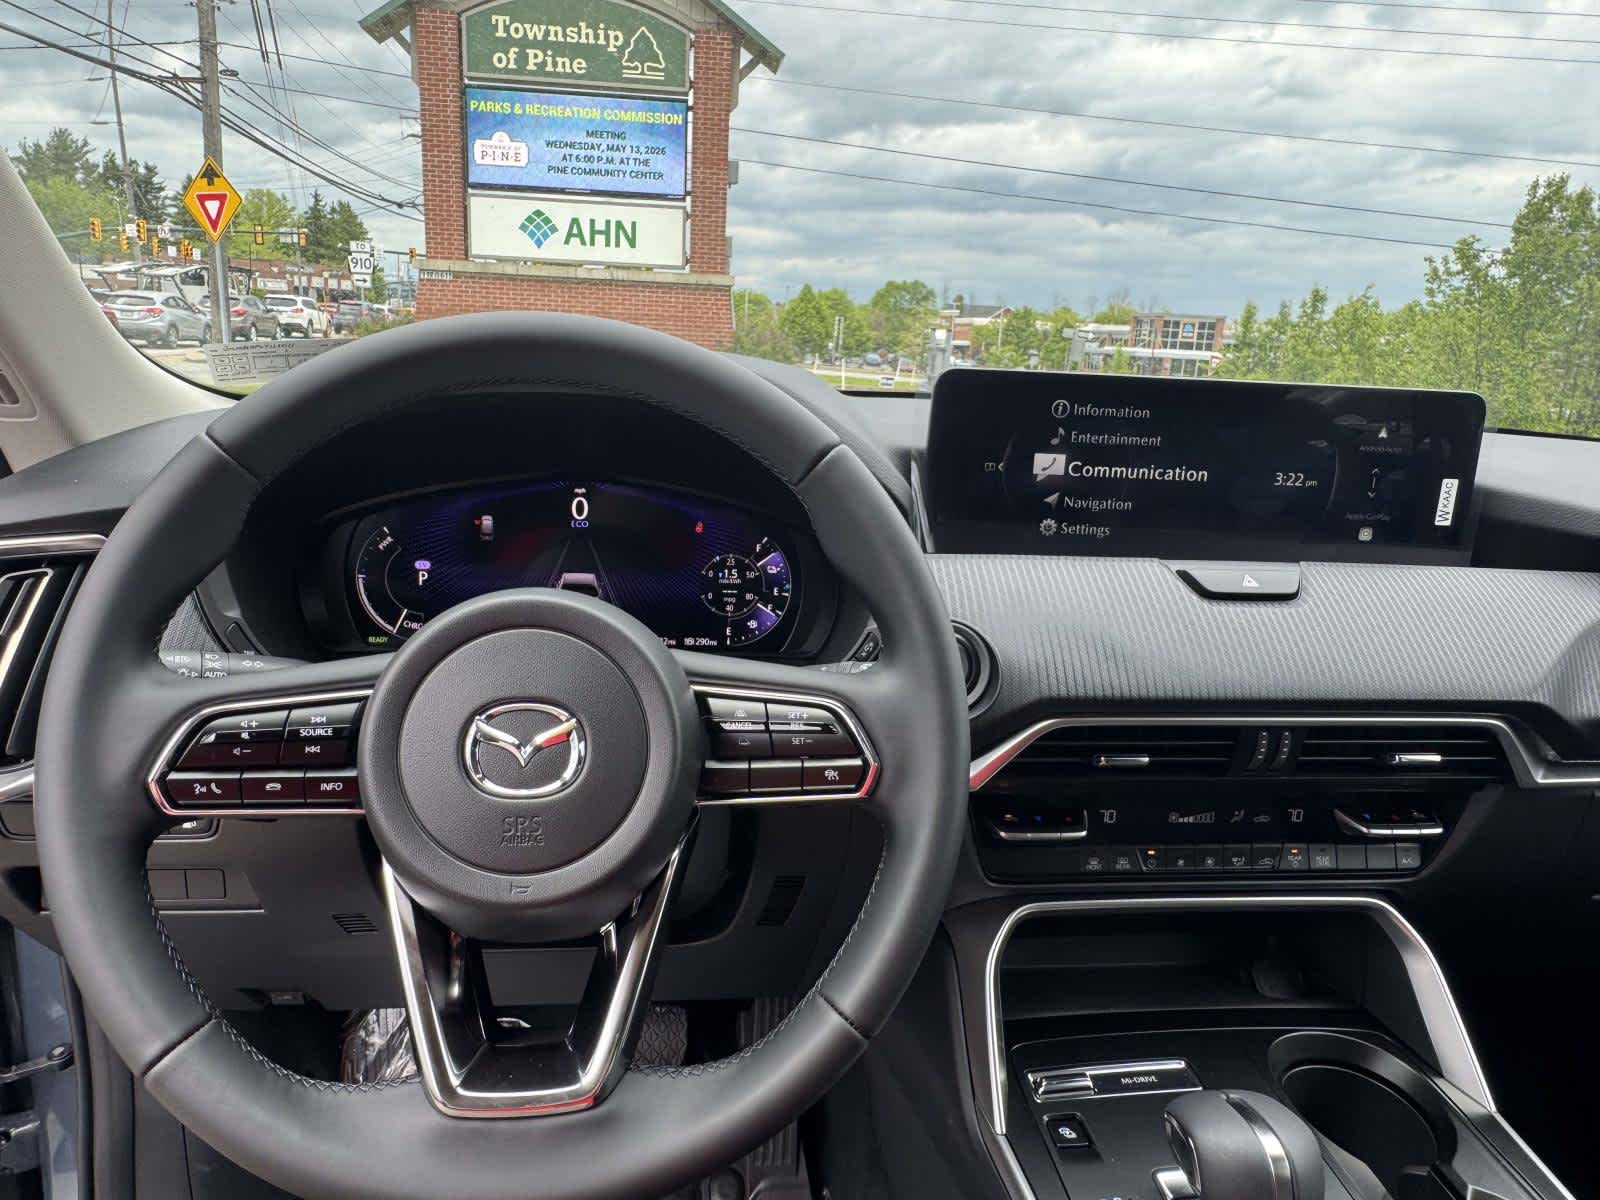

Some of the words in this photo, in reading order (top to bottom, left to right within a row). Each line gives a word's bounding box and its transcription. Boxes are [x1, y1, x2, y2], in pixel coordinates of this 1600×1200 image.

[491, 15, 623, 52] Township
[492, 47, 519, 69] of
[525, 49, 588, 74] Pine
[470, 100, 511, 115] PARKS
[513, 104, 522, 115] &
[526, 103, 600, 119] RECREATION
[604, 108, 682, 125] COMMISSION
[586, 130, 626, 140] MEETING
[545, 140, 604, 153] WEDNESDAY,
[606, 144, 626, 153] MAY
[629, 145, 642, 155] 13,
[644, 146, 666, 155] 2026
[561, 153, 573, 163] AT
[575, 154, 595, 165] 6:00
[596, 156, 616, 165] P.M.
[619, 157, 630, 166] AT
[632, 157, 651, 167] THE
[547, 165, 569, 175] PINE
[570, 166, 627, 178] COMMUNITY
[629, 170, 665, 181] CENTER
[564, 217, 637, 249] AHN
[350, 257, 371, 270] 910
[1074, 403, 1151, 419] Information
[1071, 431, 1163, 448] Entertainment
[1068, 461, 1209, 483] Communication
[1273, 472, 1304, 487] 3:22
[1305, 480, 1318, 488] pm
[571, 496, 589, 521] 0
[1063, 495, 1133, 512] Navigation
[1060, 522, 1112, 539] Settings
[756, 543, 762, 552] F
[418, 571, 429, 586] P
[724, 568, 738, 579] 1.5
[707, 592, 713, 600] 0
[773, 587, 779, 596] E
[725, 604, 734, 612] 40
[726, 626, 732, 636] E
[299, 727, 333, 737] SOURCE
[320, 782, 343, 792] INFO
[1100, 809, 1117, 824] 70
[1288, 809, 1304, 823] 70
